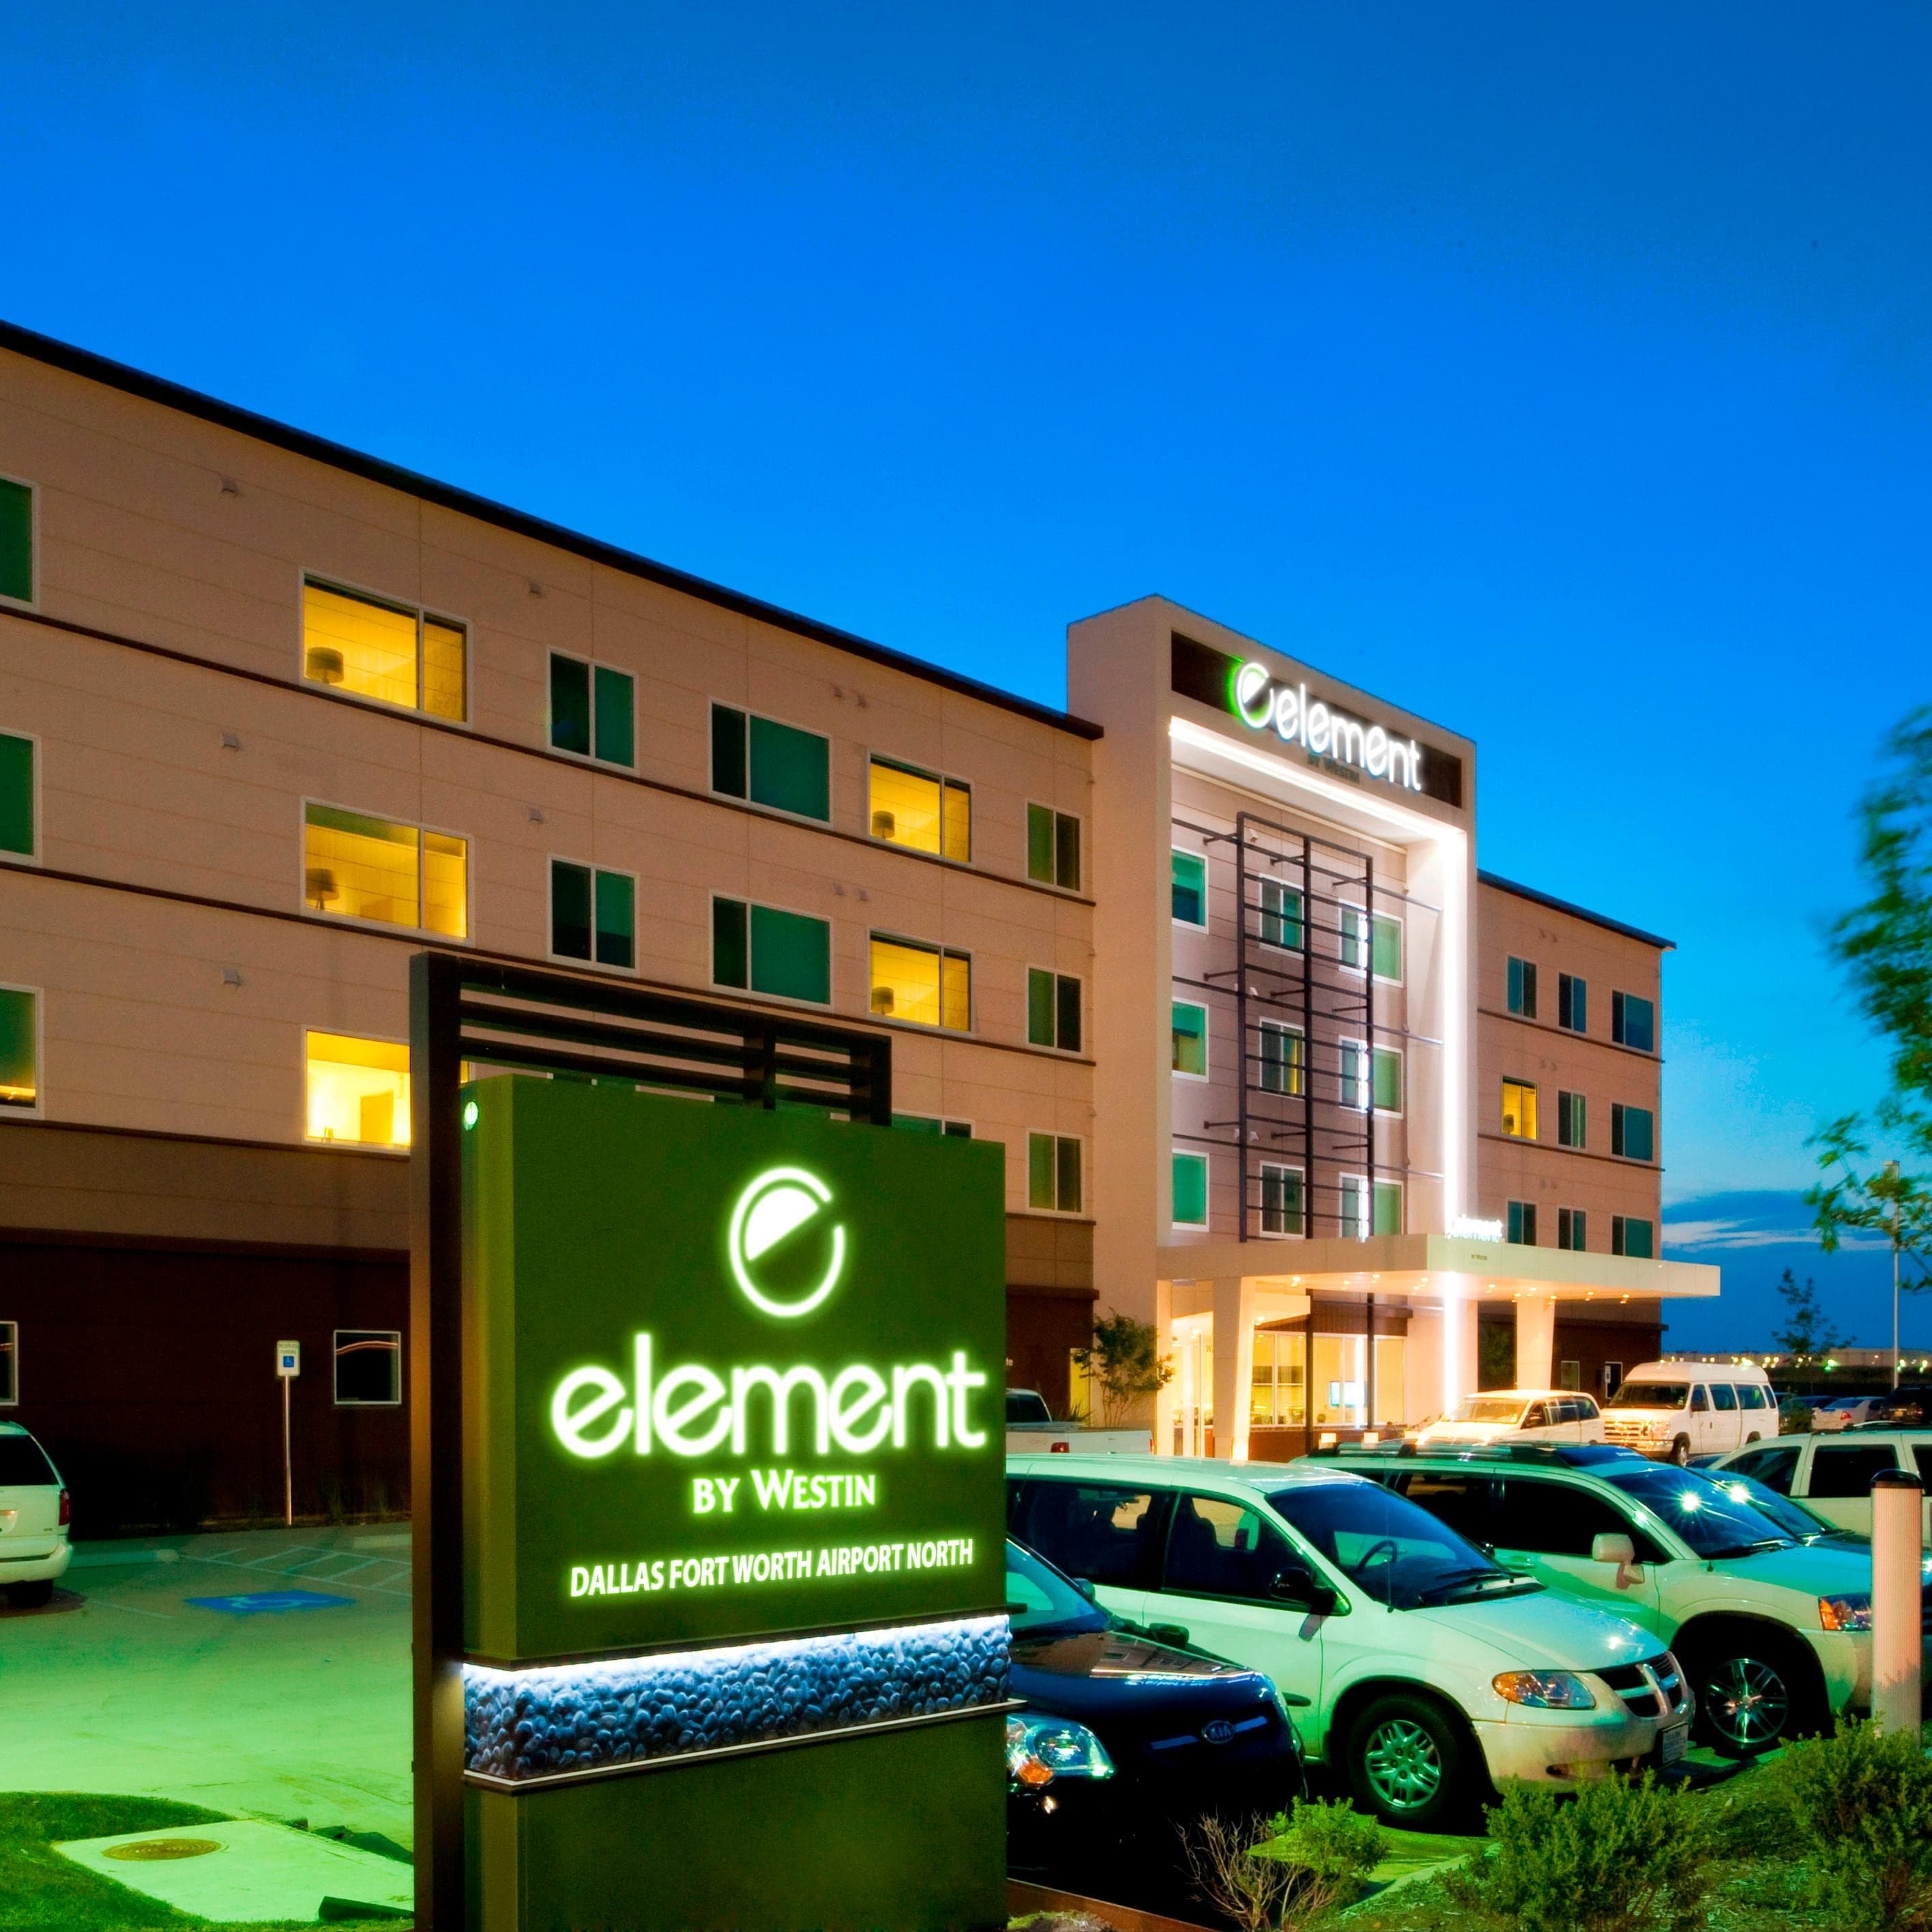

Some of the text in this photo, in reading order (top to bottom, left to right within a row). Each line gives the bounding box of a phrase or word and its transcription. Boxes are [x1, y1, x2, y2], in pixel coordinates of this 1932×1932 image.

[1276, 682, 1422, 791] element
[551, 1332, 987, 1459] element
[692, 1478, 740, 1513] BY
[570, 1538, 973, 1597] DALLAS FORT WORTH AIRPORT NORTH
